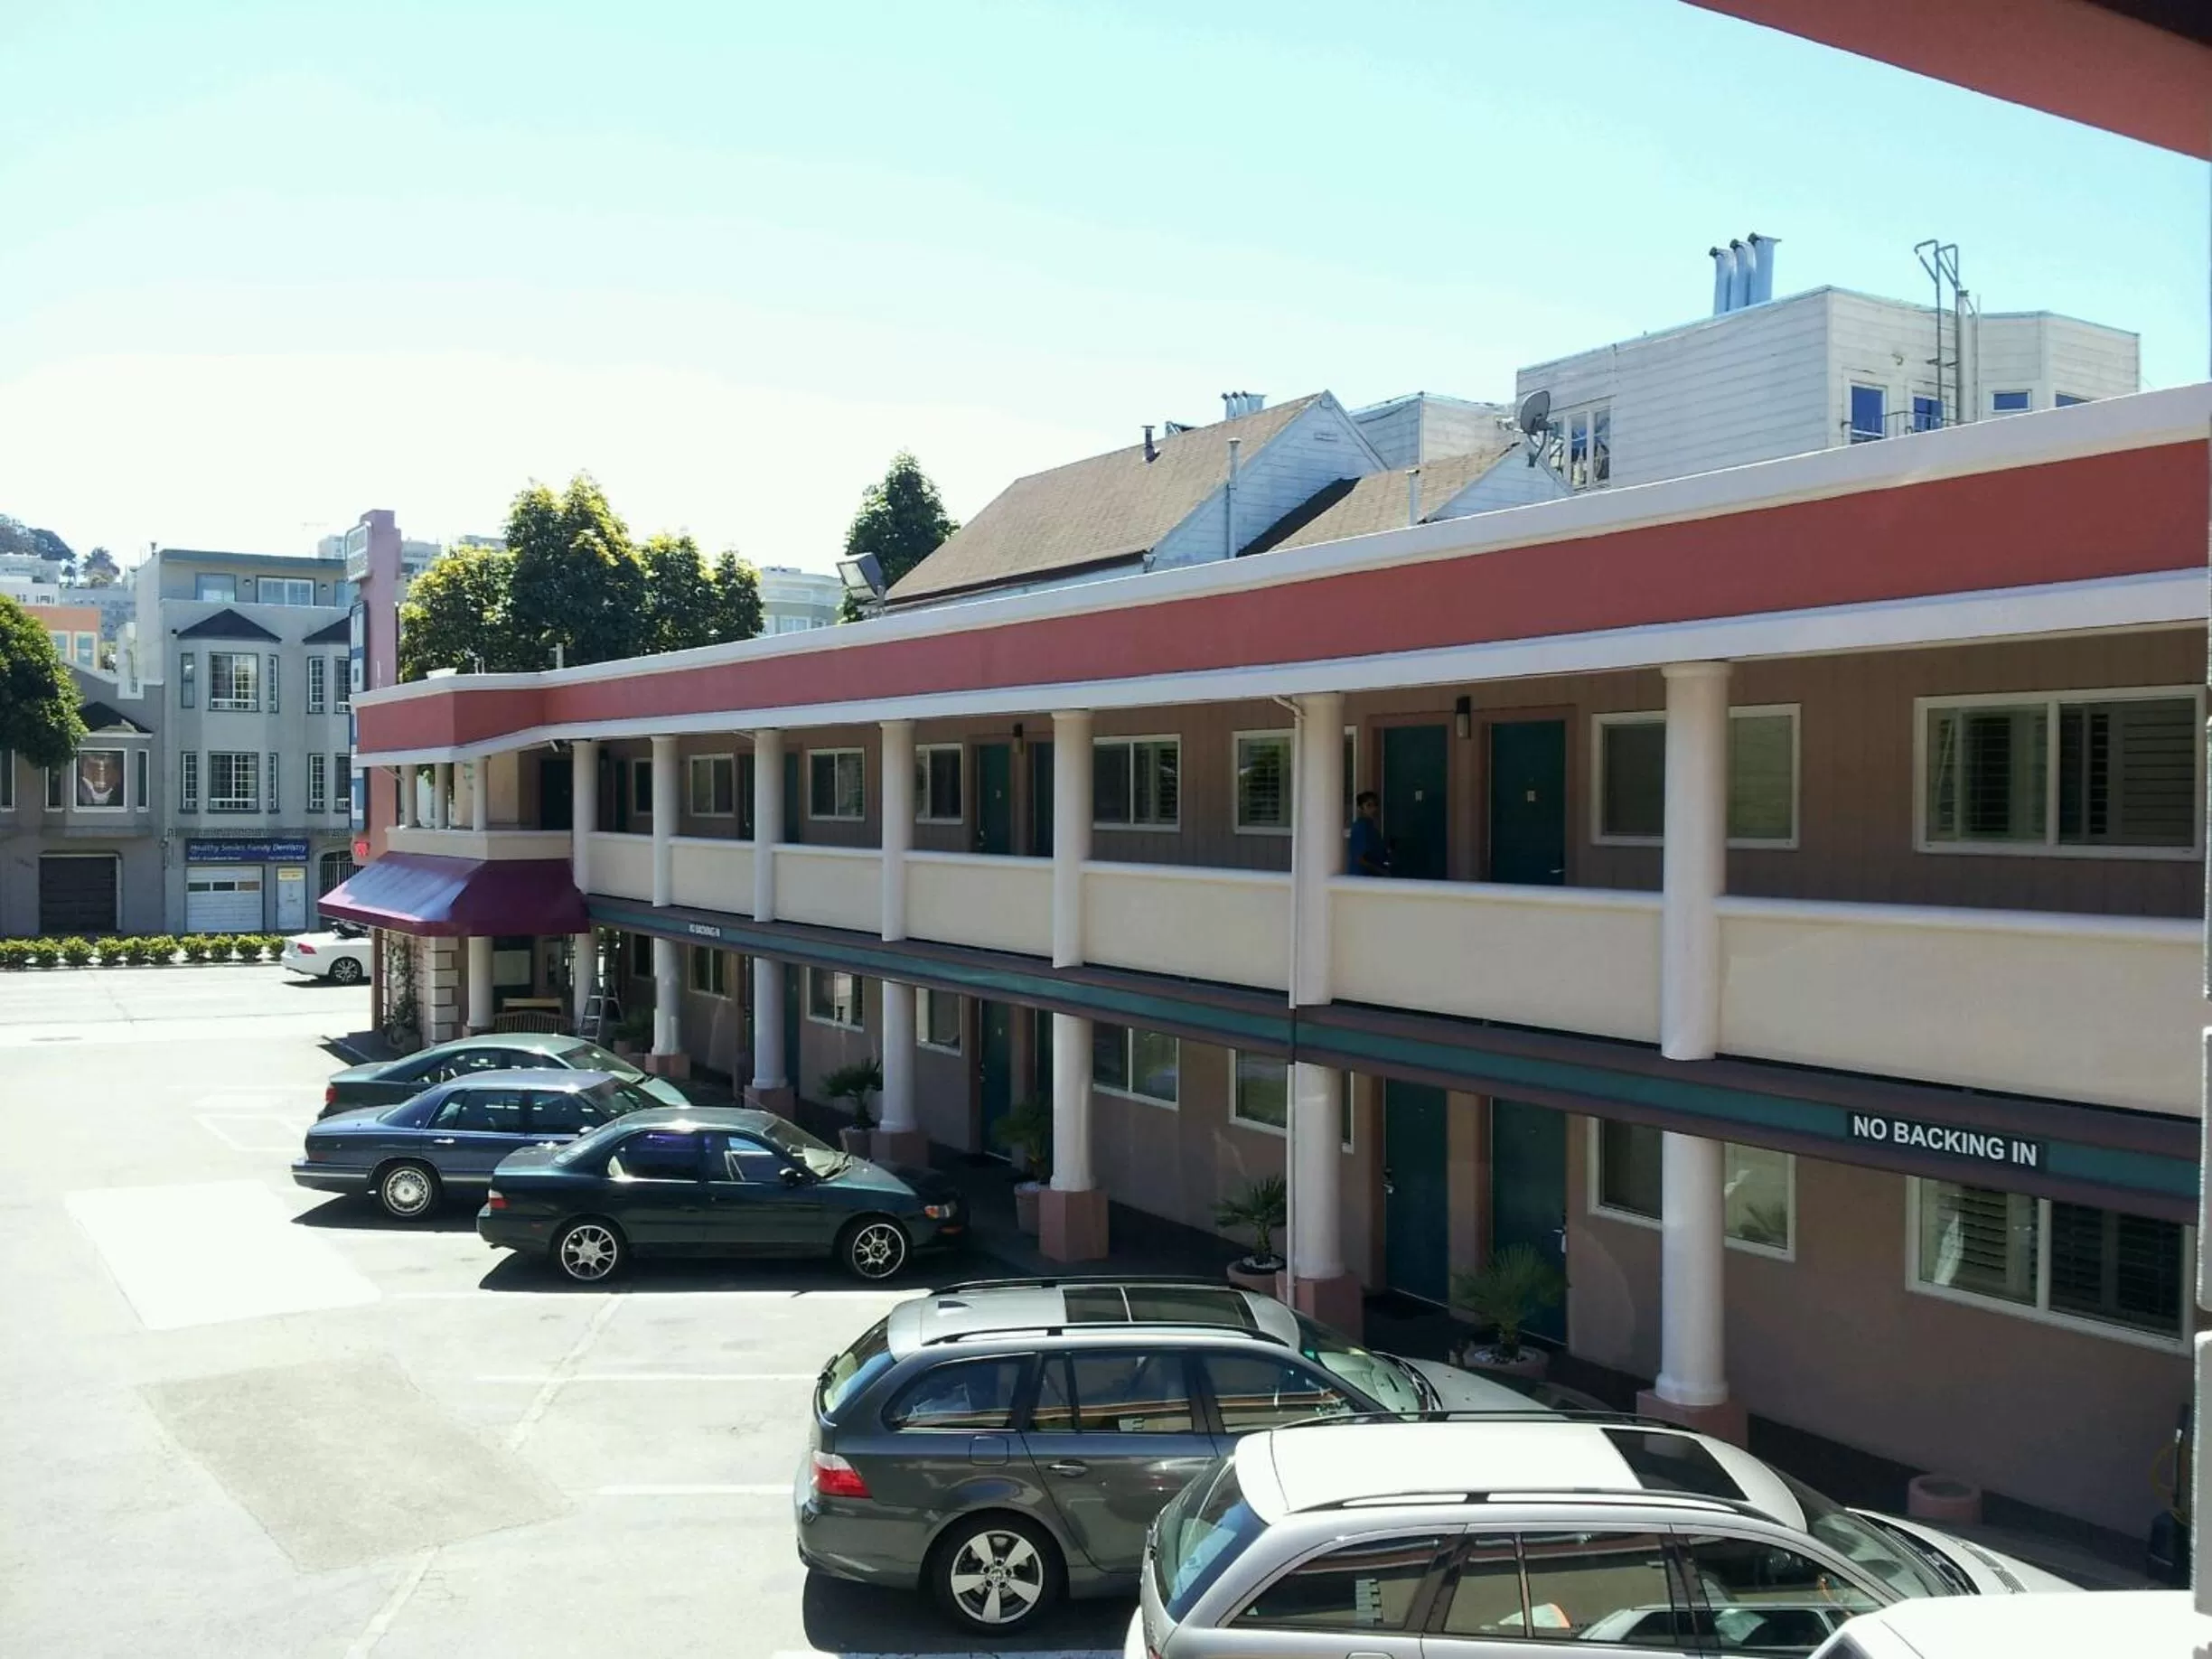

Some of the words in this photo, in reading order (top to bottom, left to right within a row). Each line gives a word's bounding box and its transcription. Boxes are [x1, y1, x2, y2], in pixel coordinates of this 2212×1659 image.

[272, 843, 306, 853] Dentistry
[1853, 1115, 1887, 1140] NO
[1894, 1120, 2005, 1160] BACKING
[2011, 1140, 2037, 1167] IN
